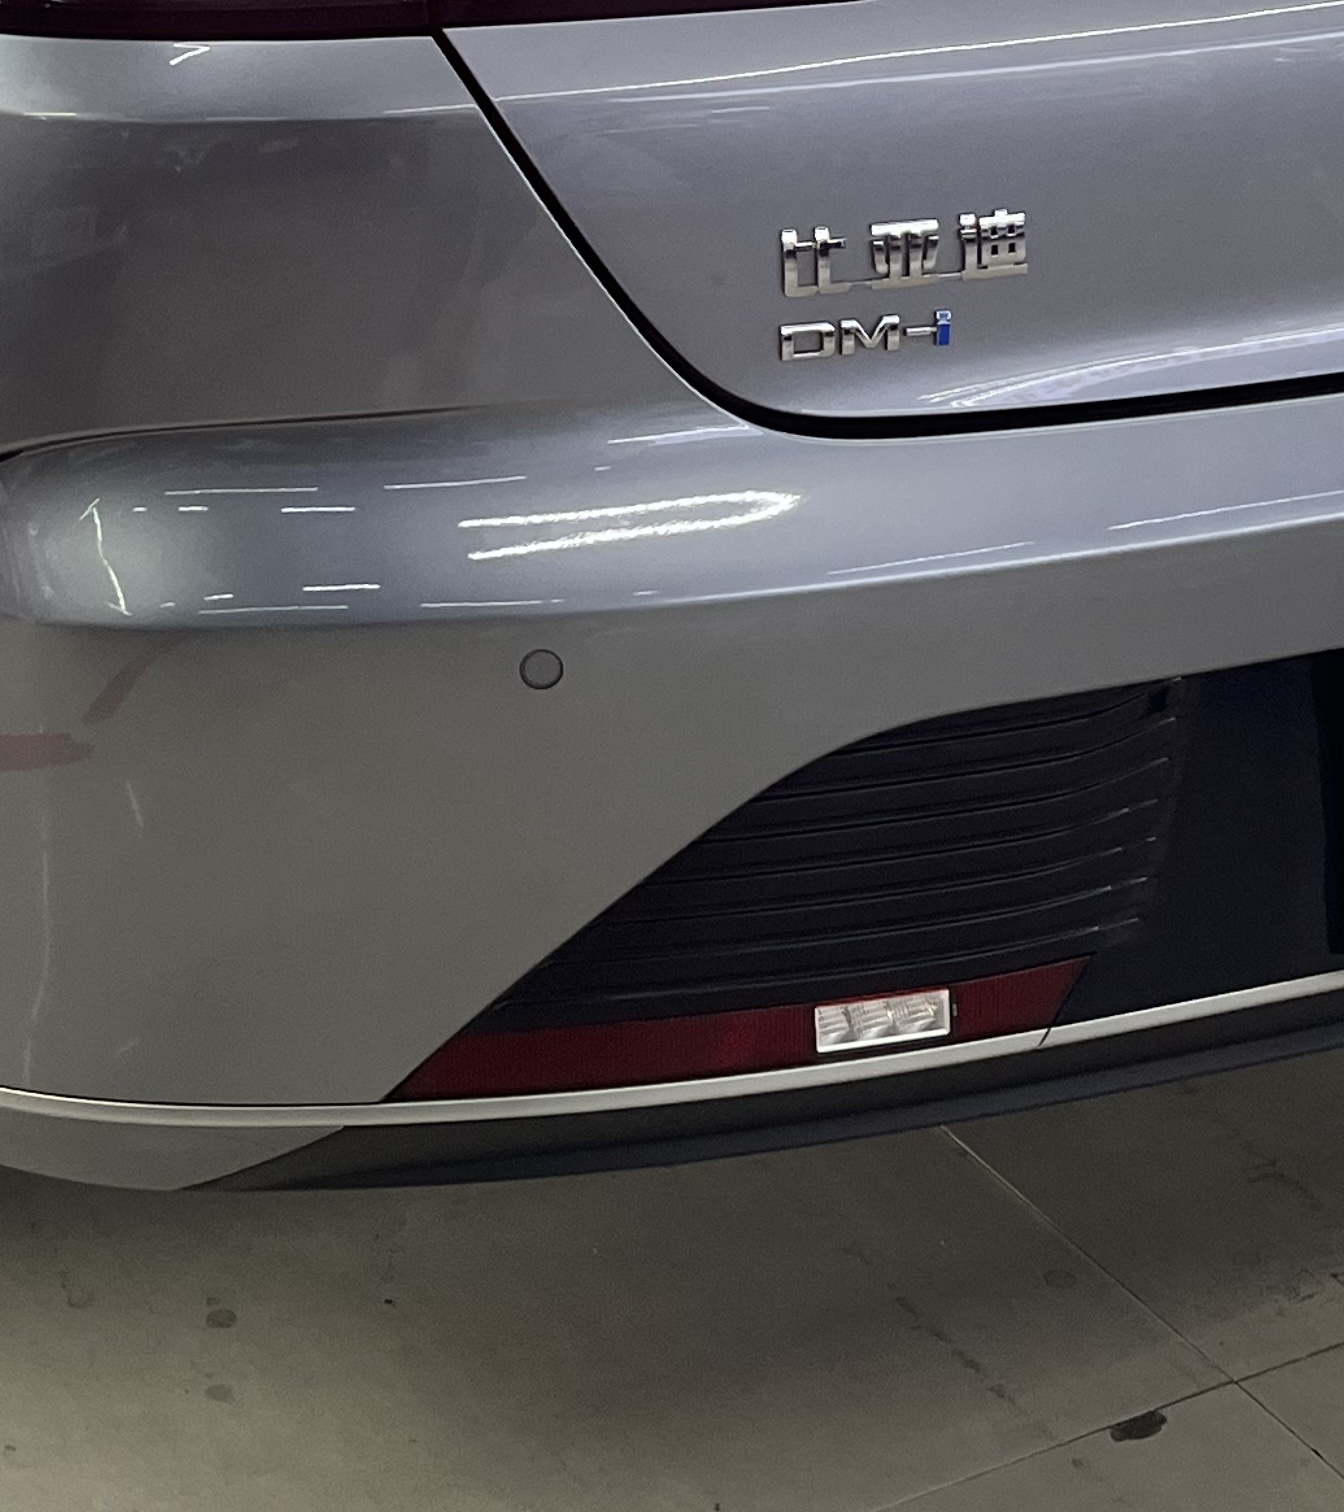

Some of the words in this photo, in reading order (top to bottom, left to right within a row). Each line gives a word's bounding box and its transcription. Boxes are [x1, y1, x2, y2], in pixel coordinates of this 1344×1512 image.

[780, 208, 1028, 298] 比亚迪
[779, 308, 952, 362] DM-i
